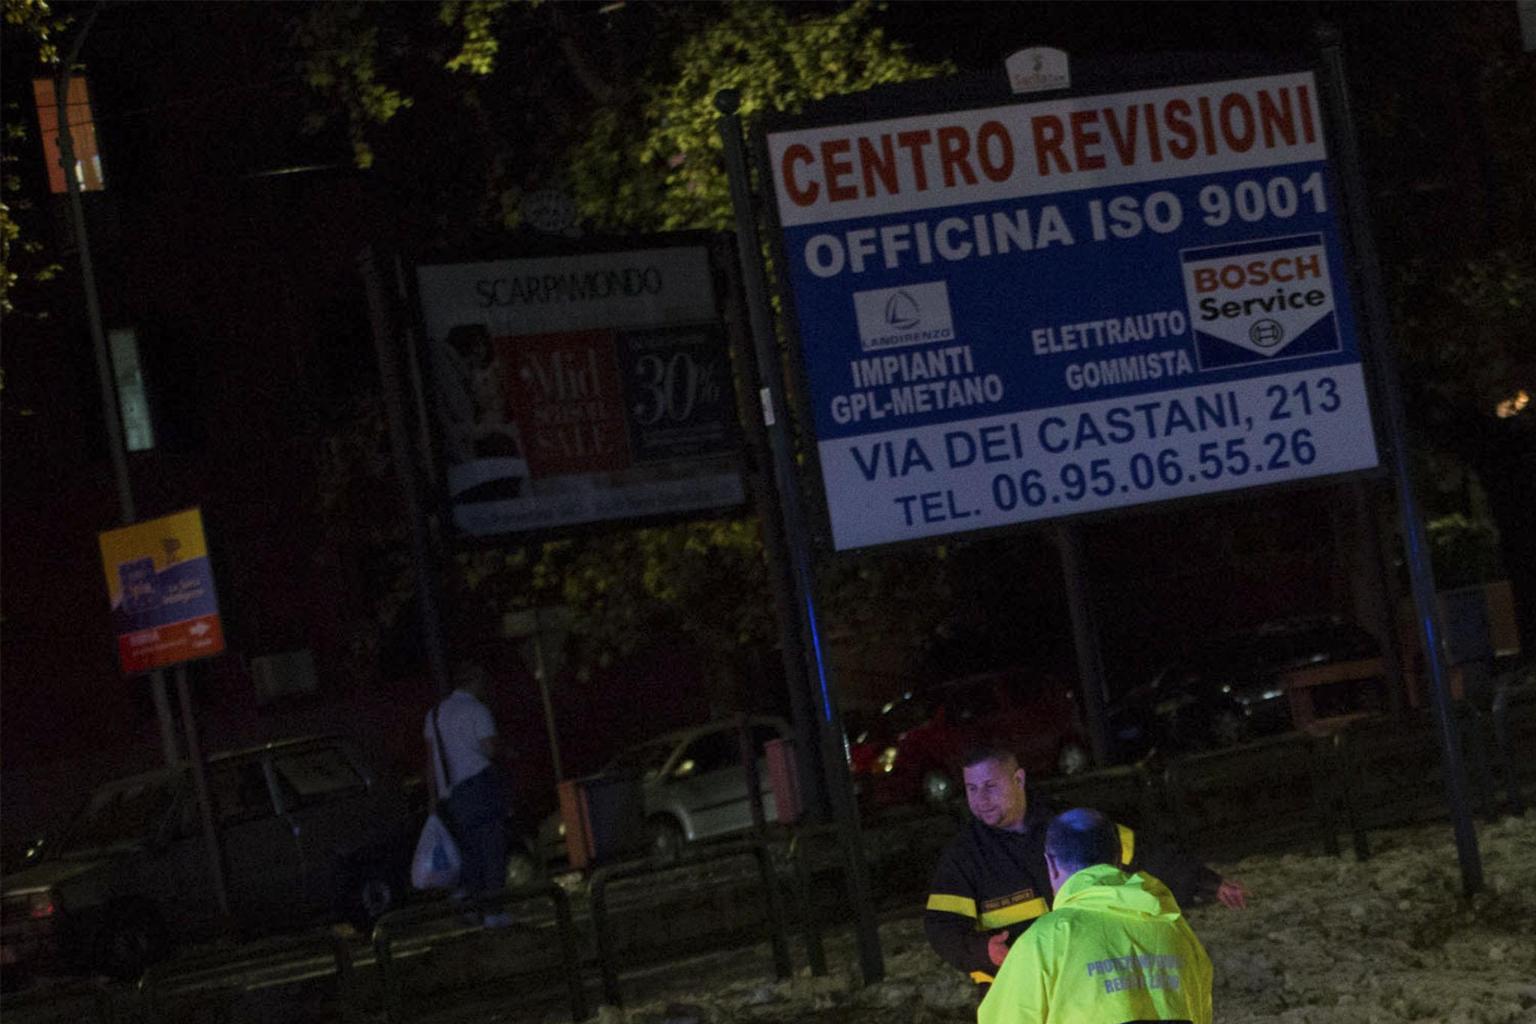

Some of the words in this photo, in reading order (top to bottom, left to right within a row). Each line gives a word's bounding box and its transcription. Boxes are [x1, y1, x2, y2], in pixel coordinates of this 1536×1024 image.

[782, 120, 1014, 208] CENTRO
[1030, 85, 1317, 177] REVISIONI
[804, 206, 1075, 278] OFFICINA
[1090, 191, 1183, 242] ISO
[1202, 172, 1328, 222] 9001
[1193, 254, 1322, 294] BOSCH
[1200, 287, 1326, 322] Service
[1031, 310, 1186, 355] ELETTRAUTO
[851, 345, 974, 388] IMPIANTI
[1065, 349, 1193, 391] GOMMISTA
[831, 374, 1004, 424] GPL-METANO
[850, 438, 934, 482] VIA
[947, 424, 1023, 469] DEI
[1038, 391, 1254, 455] CASTANI,
[1266, 376, 1342, 422] 213
[894, 494, 981, 528] TEL.
[992, 428, 1317, 512] 06.95.06.55.26
